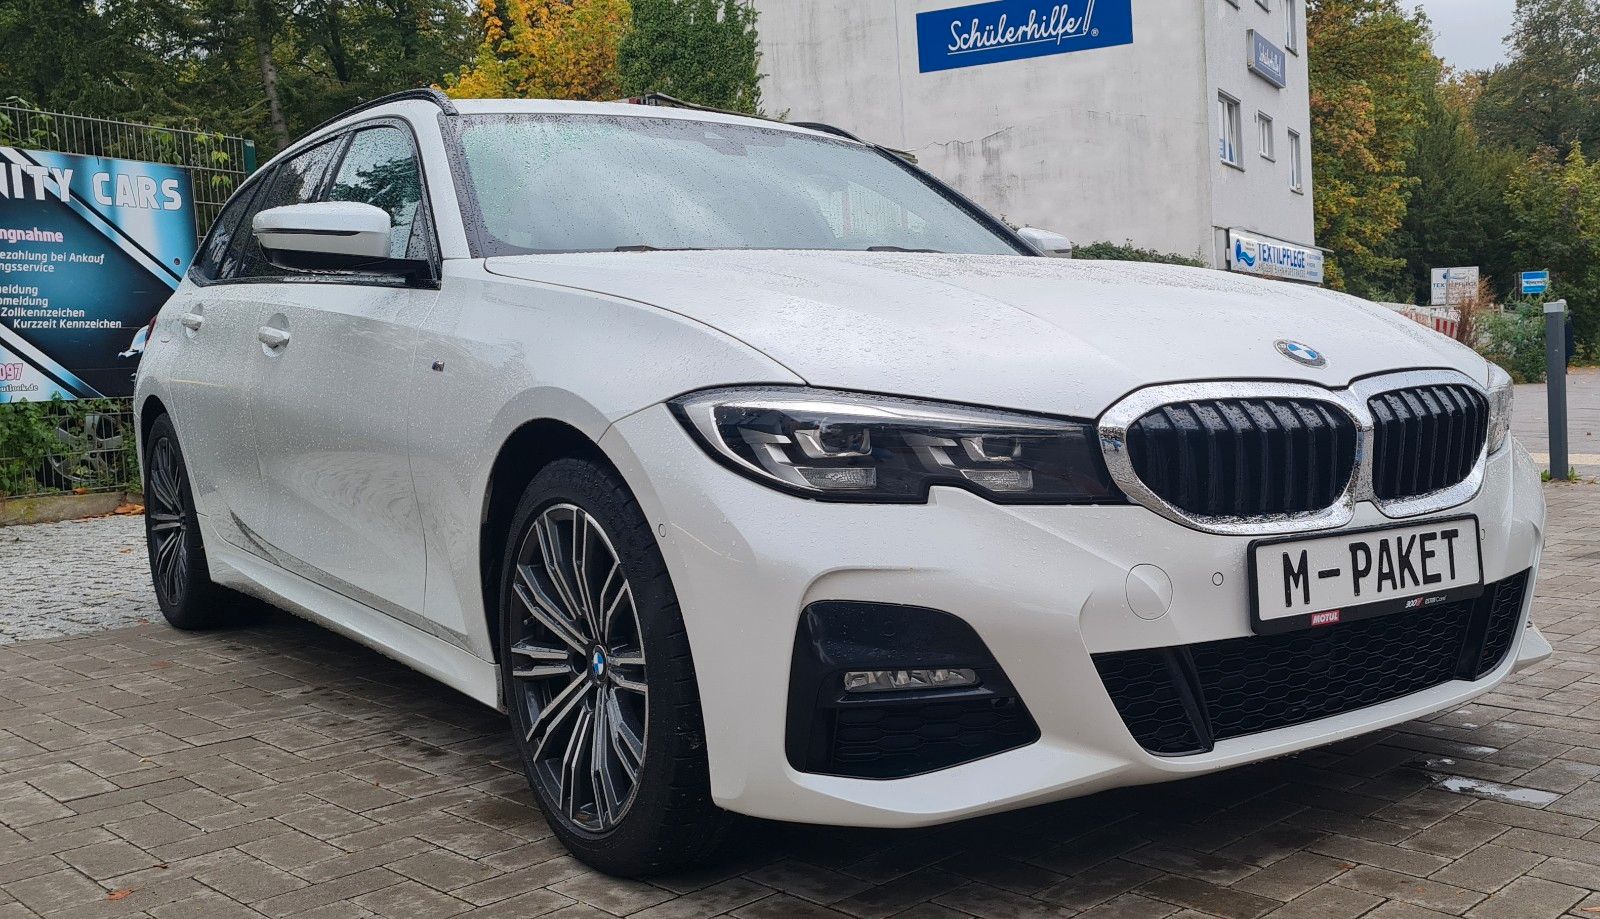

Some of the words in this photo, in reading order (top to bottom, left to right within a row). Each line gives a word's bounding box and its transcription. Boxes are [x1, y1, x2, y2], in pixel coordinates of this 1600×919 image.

[92, 172, 182, 211] CARS
[0, 227, 64, 243] ngnahme
[51, 252, 67, 262] bei
[69, 252, 105, 265] Ankauf
[1257, 242, 1305, 269] TEXTILPFLEGE
[0, 284, 38, 297] eldung
[1, 307, 85, 317] Zollkennzeichen
[13, 319, 57, 329] Kurzzeit
[60, 319, 122, 329] Kennzeichen
[1312, 611, 1339, 625] MOTUL
